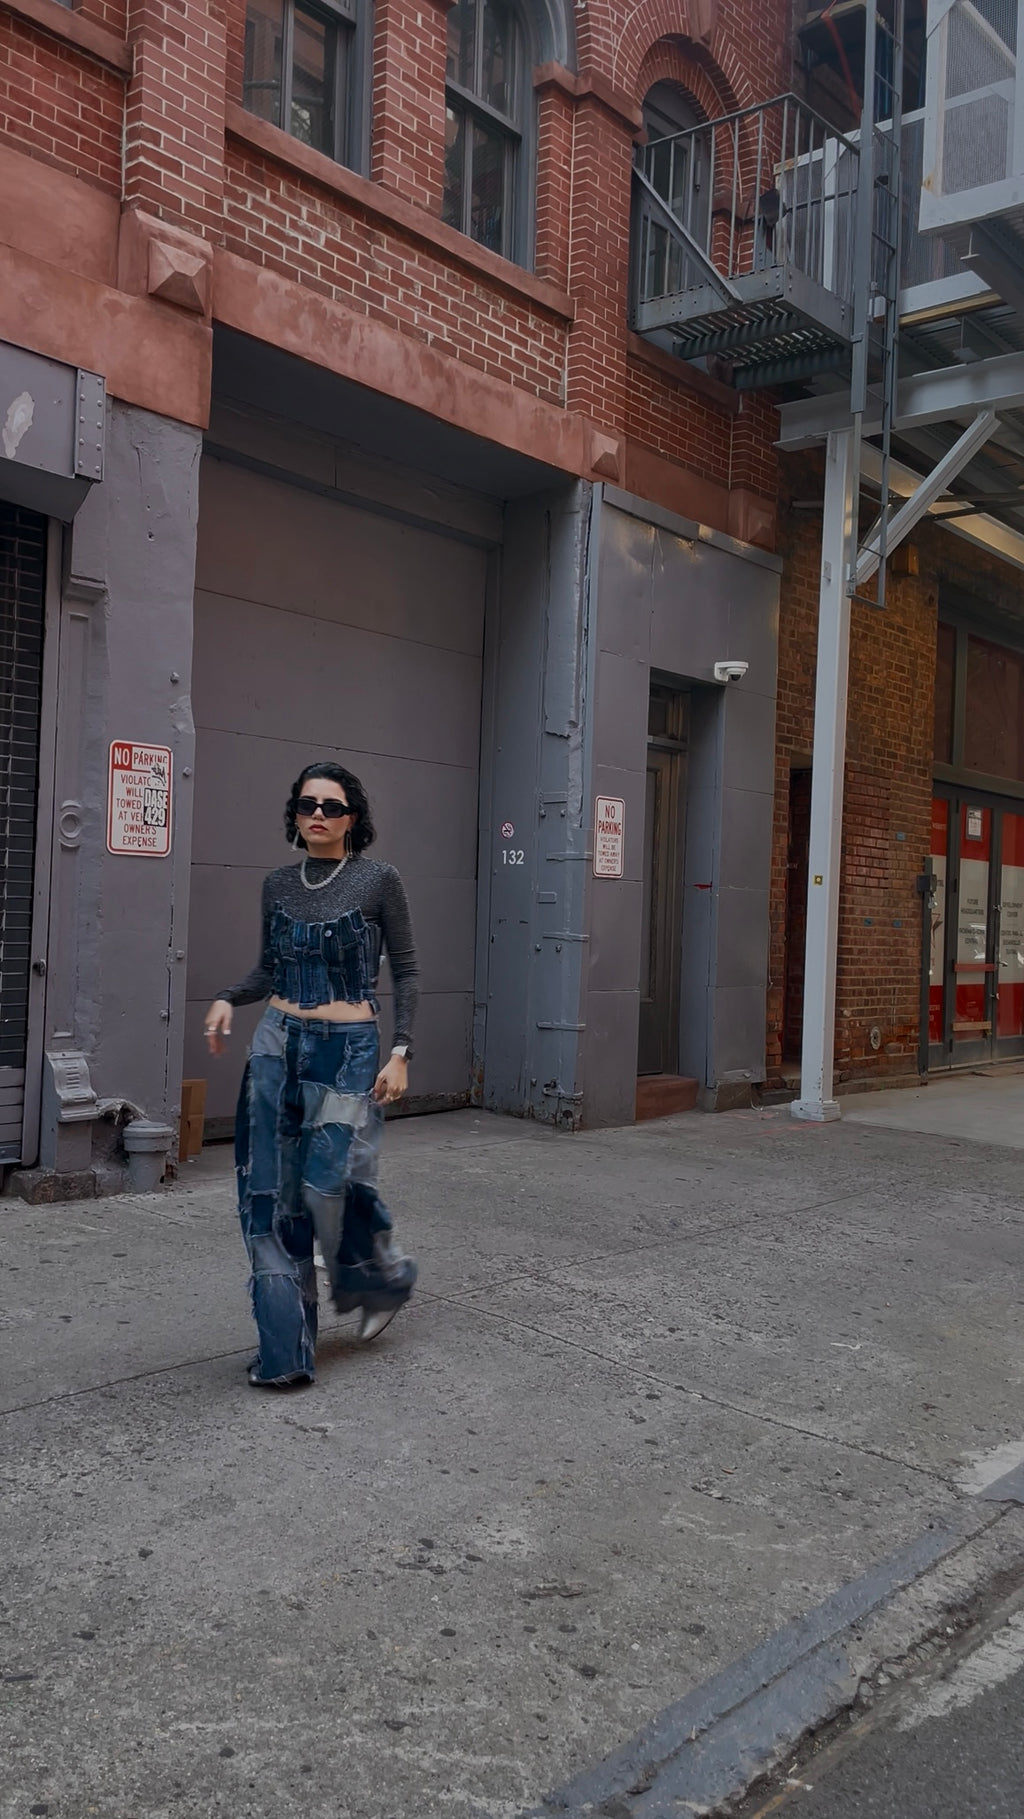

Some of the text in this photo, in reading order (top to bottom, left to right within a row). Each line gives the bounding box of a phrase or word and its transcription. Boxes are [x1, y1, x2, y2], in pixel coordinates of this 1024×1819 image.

[114, 746, 130, 766] NO
[125, 786, 143, 798] WILL
[145, 789, 168, 809] DASE
[116, 798, 142, 810] TOWED
[605, 804, 616, 819] NO
[118, 811, 128, 821] AT
[145, 806, 166, 827] 429
[598, 820, 622, 835] PARKING
[122, 835, 157, 848] EXPENSE
[502, 849, 525, 865] 132
